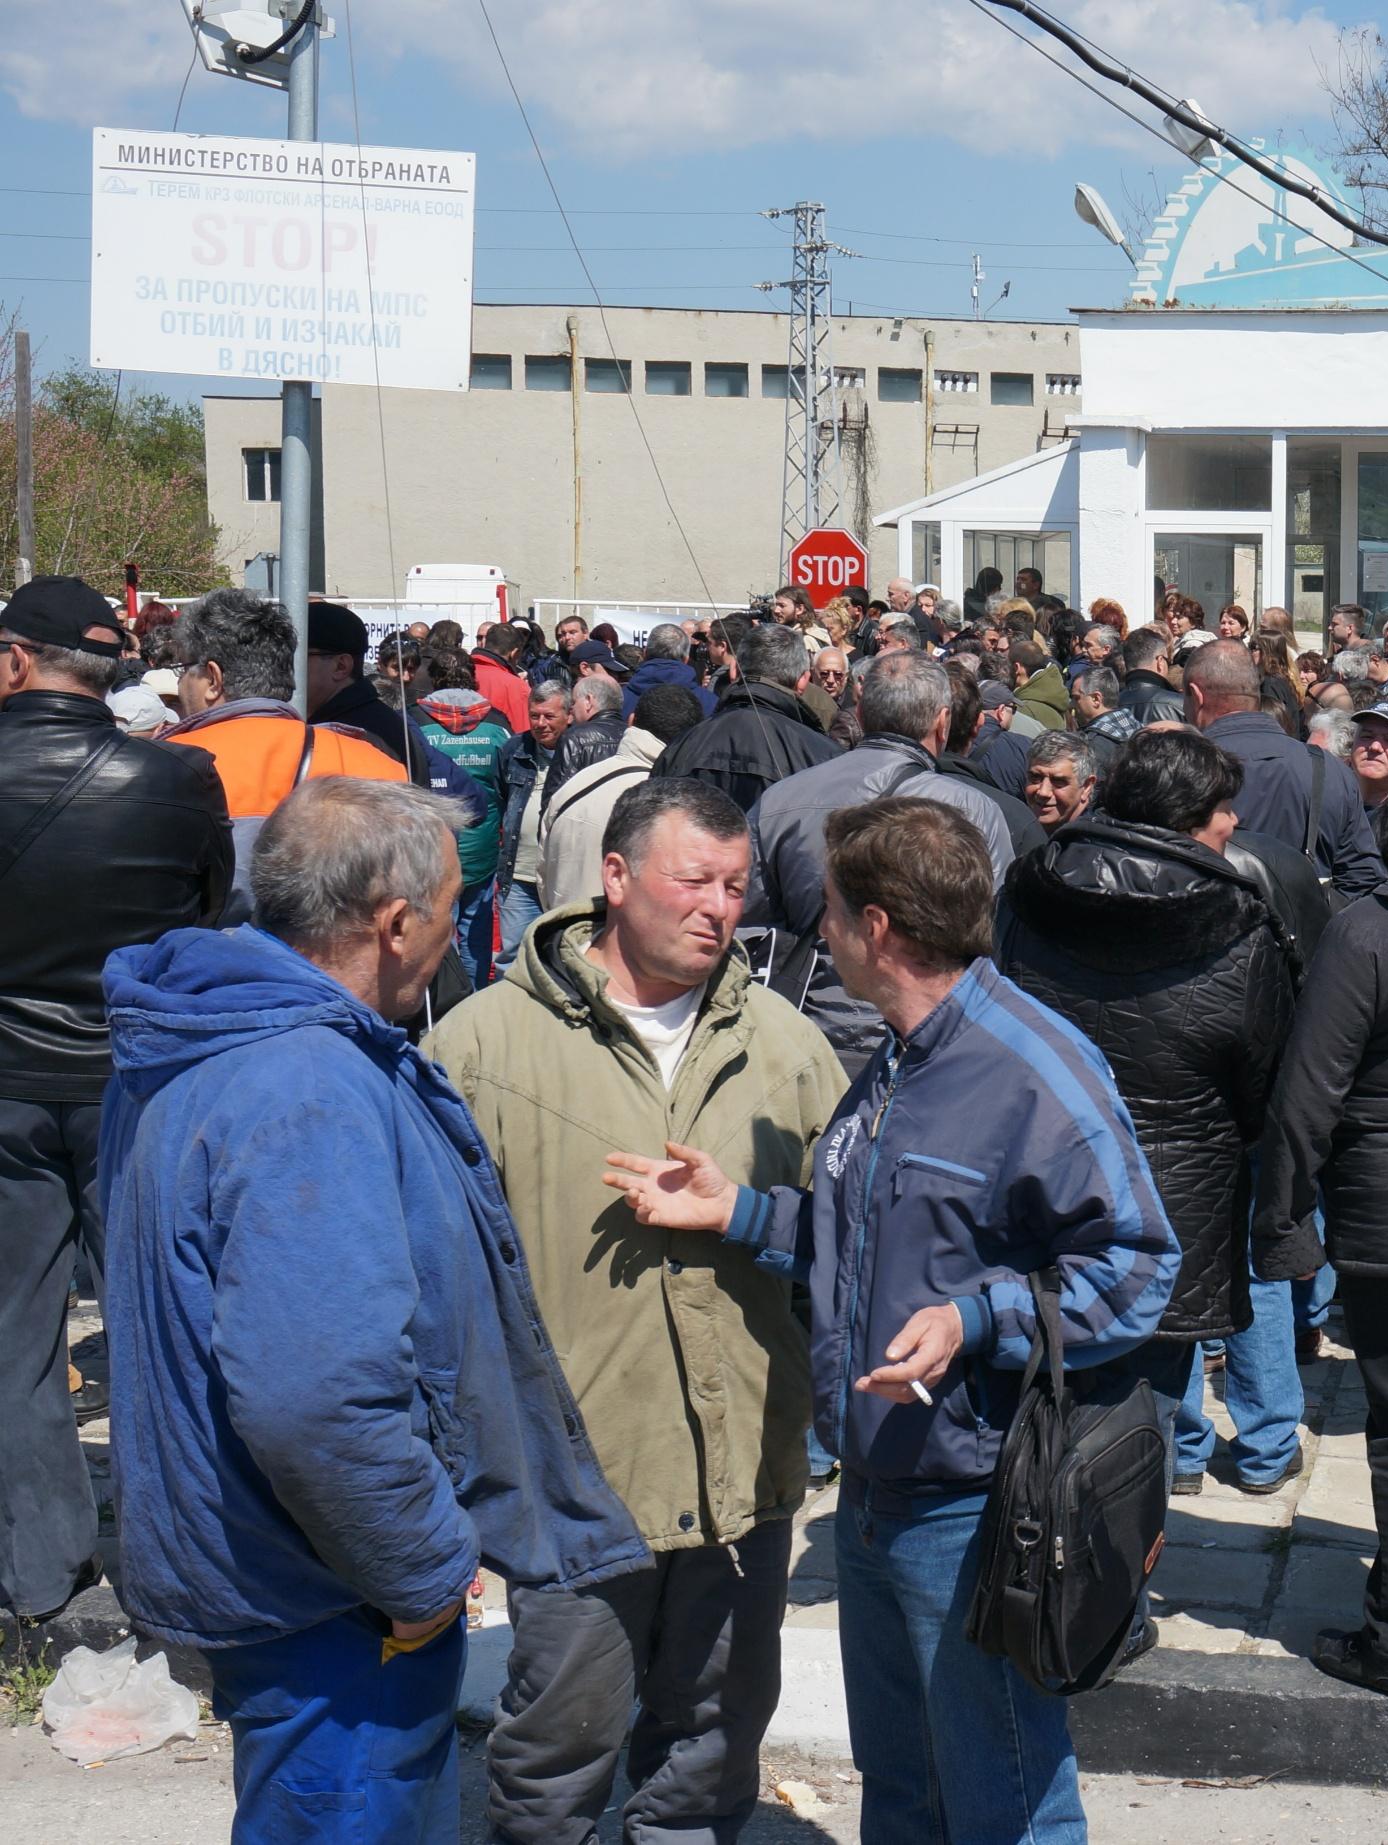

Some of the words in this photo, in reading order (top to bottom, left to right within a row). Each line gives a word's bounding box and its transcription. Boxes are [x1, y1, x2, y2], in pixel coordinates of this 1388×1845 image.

[118, 144, 288, 173] МИНИСТЕРСТВО
[297, 156, 323, 176] НА
[331, 159, 451, 184] ОТБРАНАТА
[149, 180, 200, 200] ТЕРЕМ
[205, 188, 230, 202] КРЗ
[234, 189, 300, 207] ФЛОТСКИ
[304, 193, 421, 215] АРСЕНАЛ-ВАРНА
[424, 201, 464, 218] ЕООД
[191, 212, 379, 276] STOP!
[135, 275, 167, 301] ЗА
[176, 278, 317, 312] ПРОПУСКИ
[328, 287, 360, 313] НА
[372, 290, 428, 318] МПС
[160, 309, 244, 339] ОТБИЙ
[255, 316, 272, 340] И
[282, 318, 402, 348] ИЗЧАКАЙ
[218, 347, 233, 370] В
[241, 350, 342, 379] ДЯСНО!
[797, 554, 860, 587] STOP
[427, 735, 440, 746] TV
[441, 734, 491, 746] Zazenhausen
